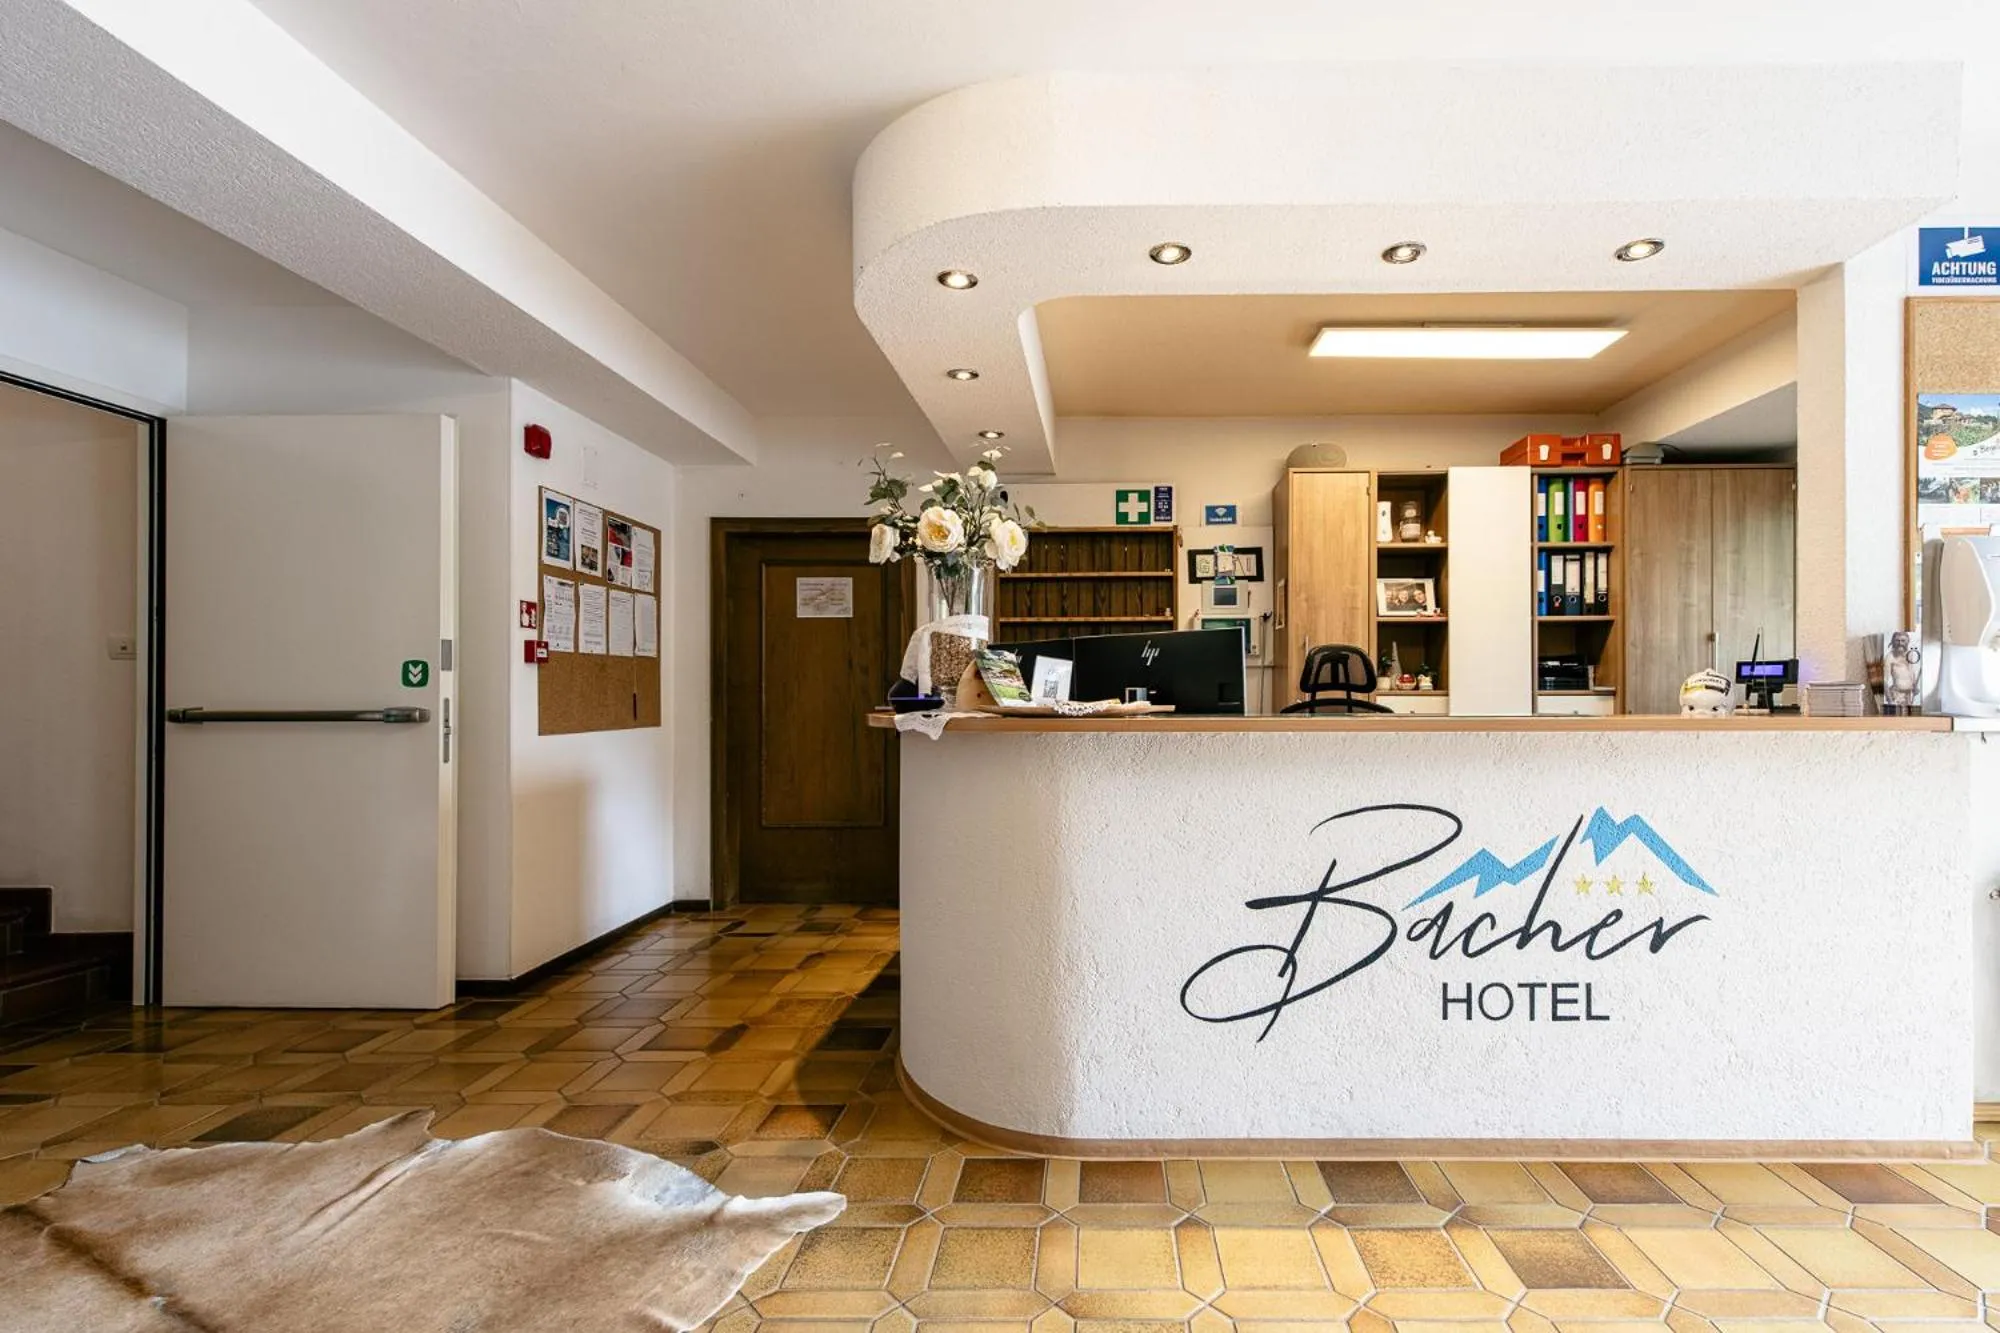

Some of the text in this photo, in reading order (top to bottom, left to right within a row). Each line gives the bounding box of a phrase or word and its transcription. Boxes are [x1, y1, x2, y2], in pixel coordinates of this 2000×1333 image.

[1931, 261, 1996, 276] ACHTUNG
[1140, 640, 1160, 666] hp
[1180, 803, 1711, 1042] Bacher
[1441, 982, 1610, 1022] HOTEL
